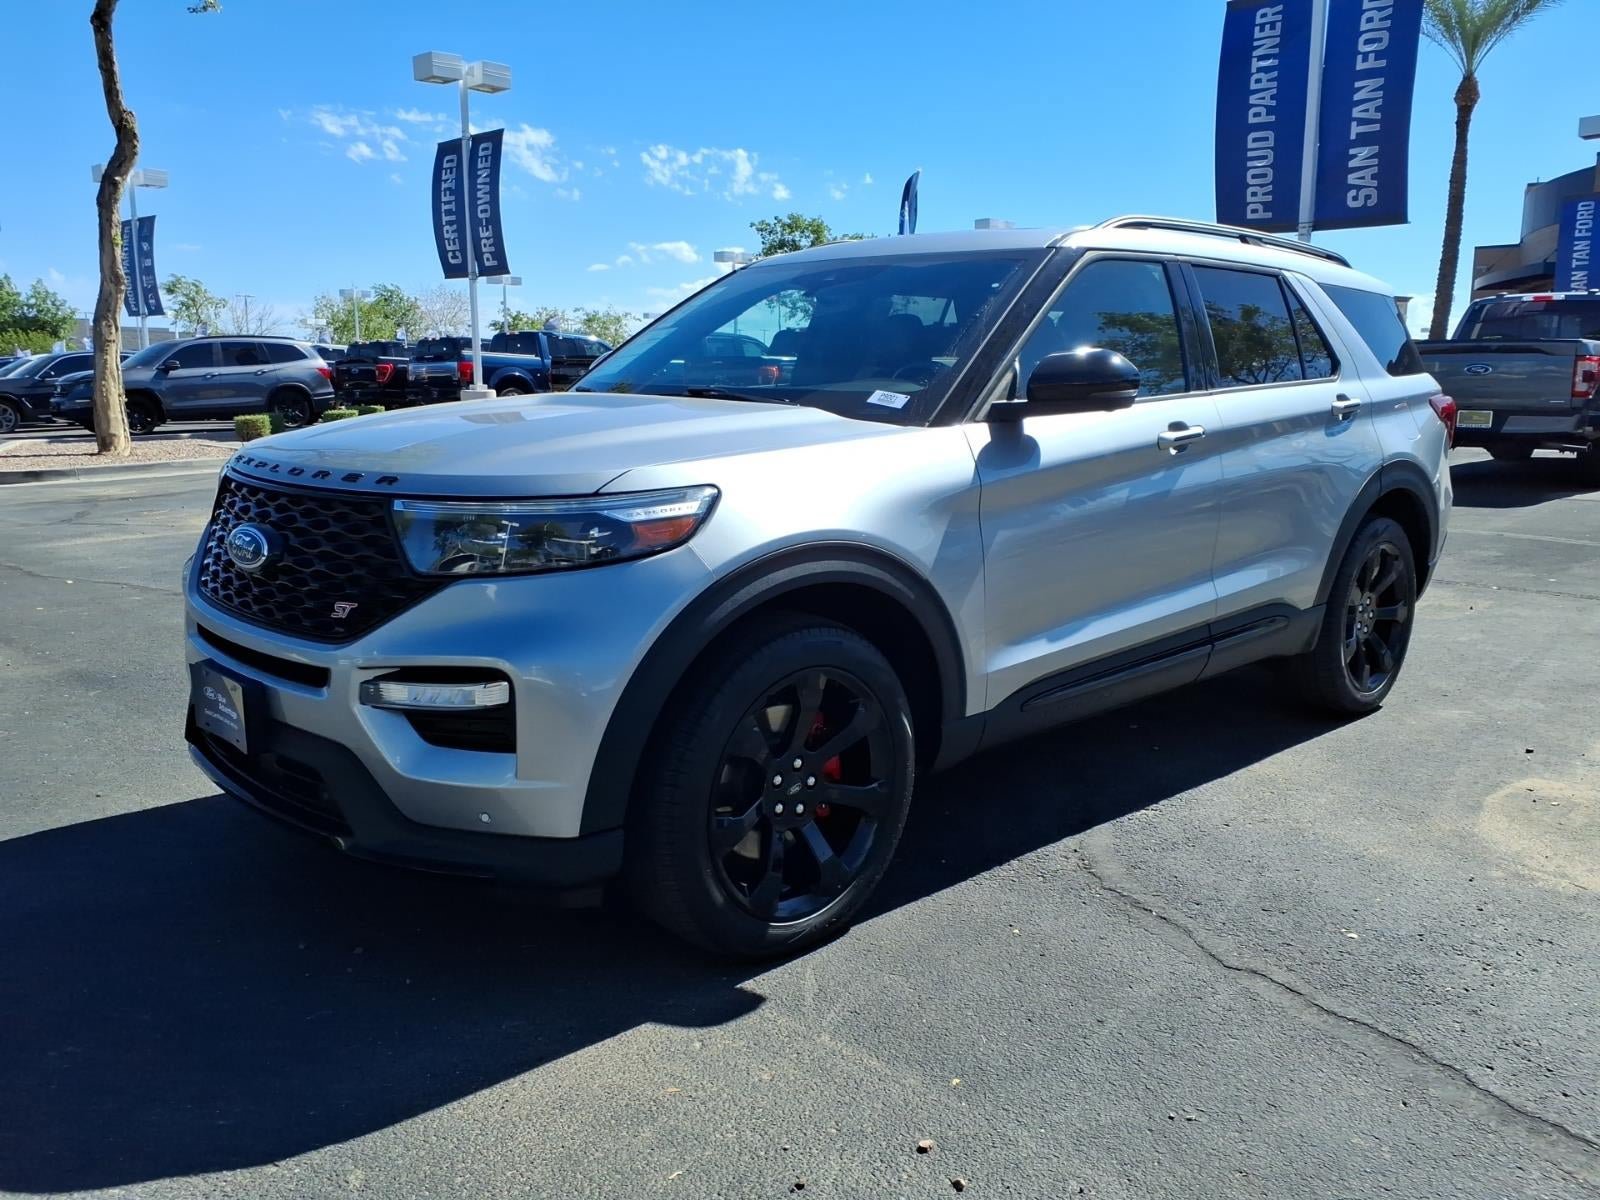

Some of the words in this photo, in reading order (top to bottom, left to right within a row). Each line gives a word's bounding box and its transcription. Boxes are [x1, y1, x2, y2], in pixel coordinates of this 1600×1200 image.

[1248, 4, 1284, 124] PARTNER
[1350, 77, 1385, 140] TAN
[476, 141, 498, 267] PRE-OWNED
[1246, 129, 1275, 220] PROUD
[1347, 145, 1379, 208] SAN
[441, 154, 463, 265] CERTIFIED
[1574, 200, 1596, 238] FORD
[1571, 240, 1591, 269] TAN
[123, 275, 138, 312] PROUD
[235, 454, 399, 487] EXPLORER
[330, 601, 358, 619] ST
